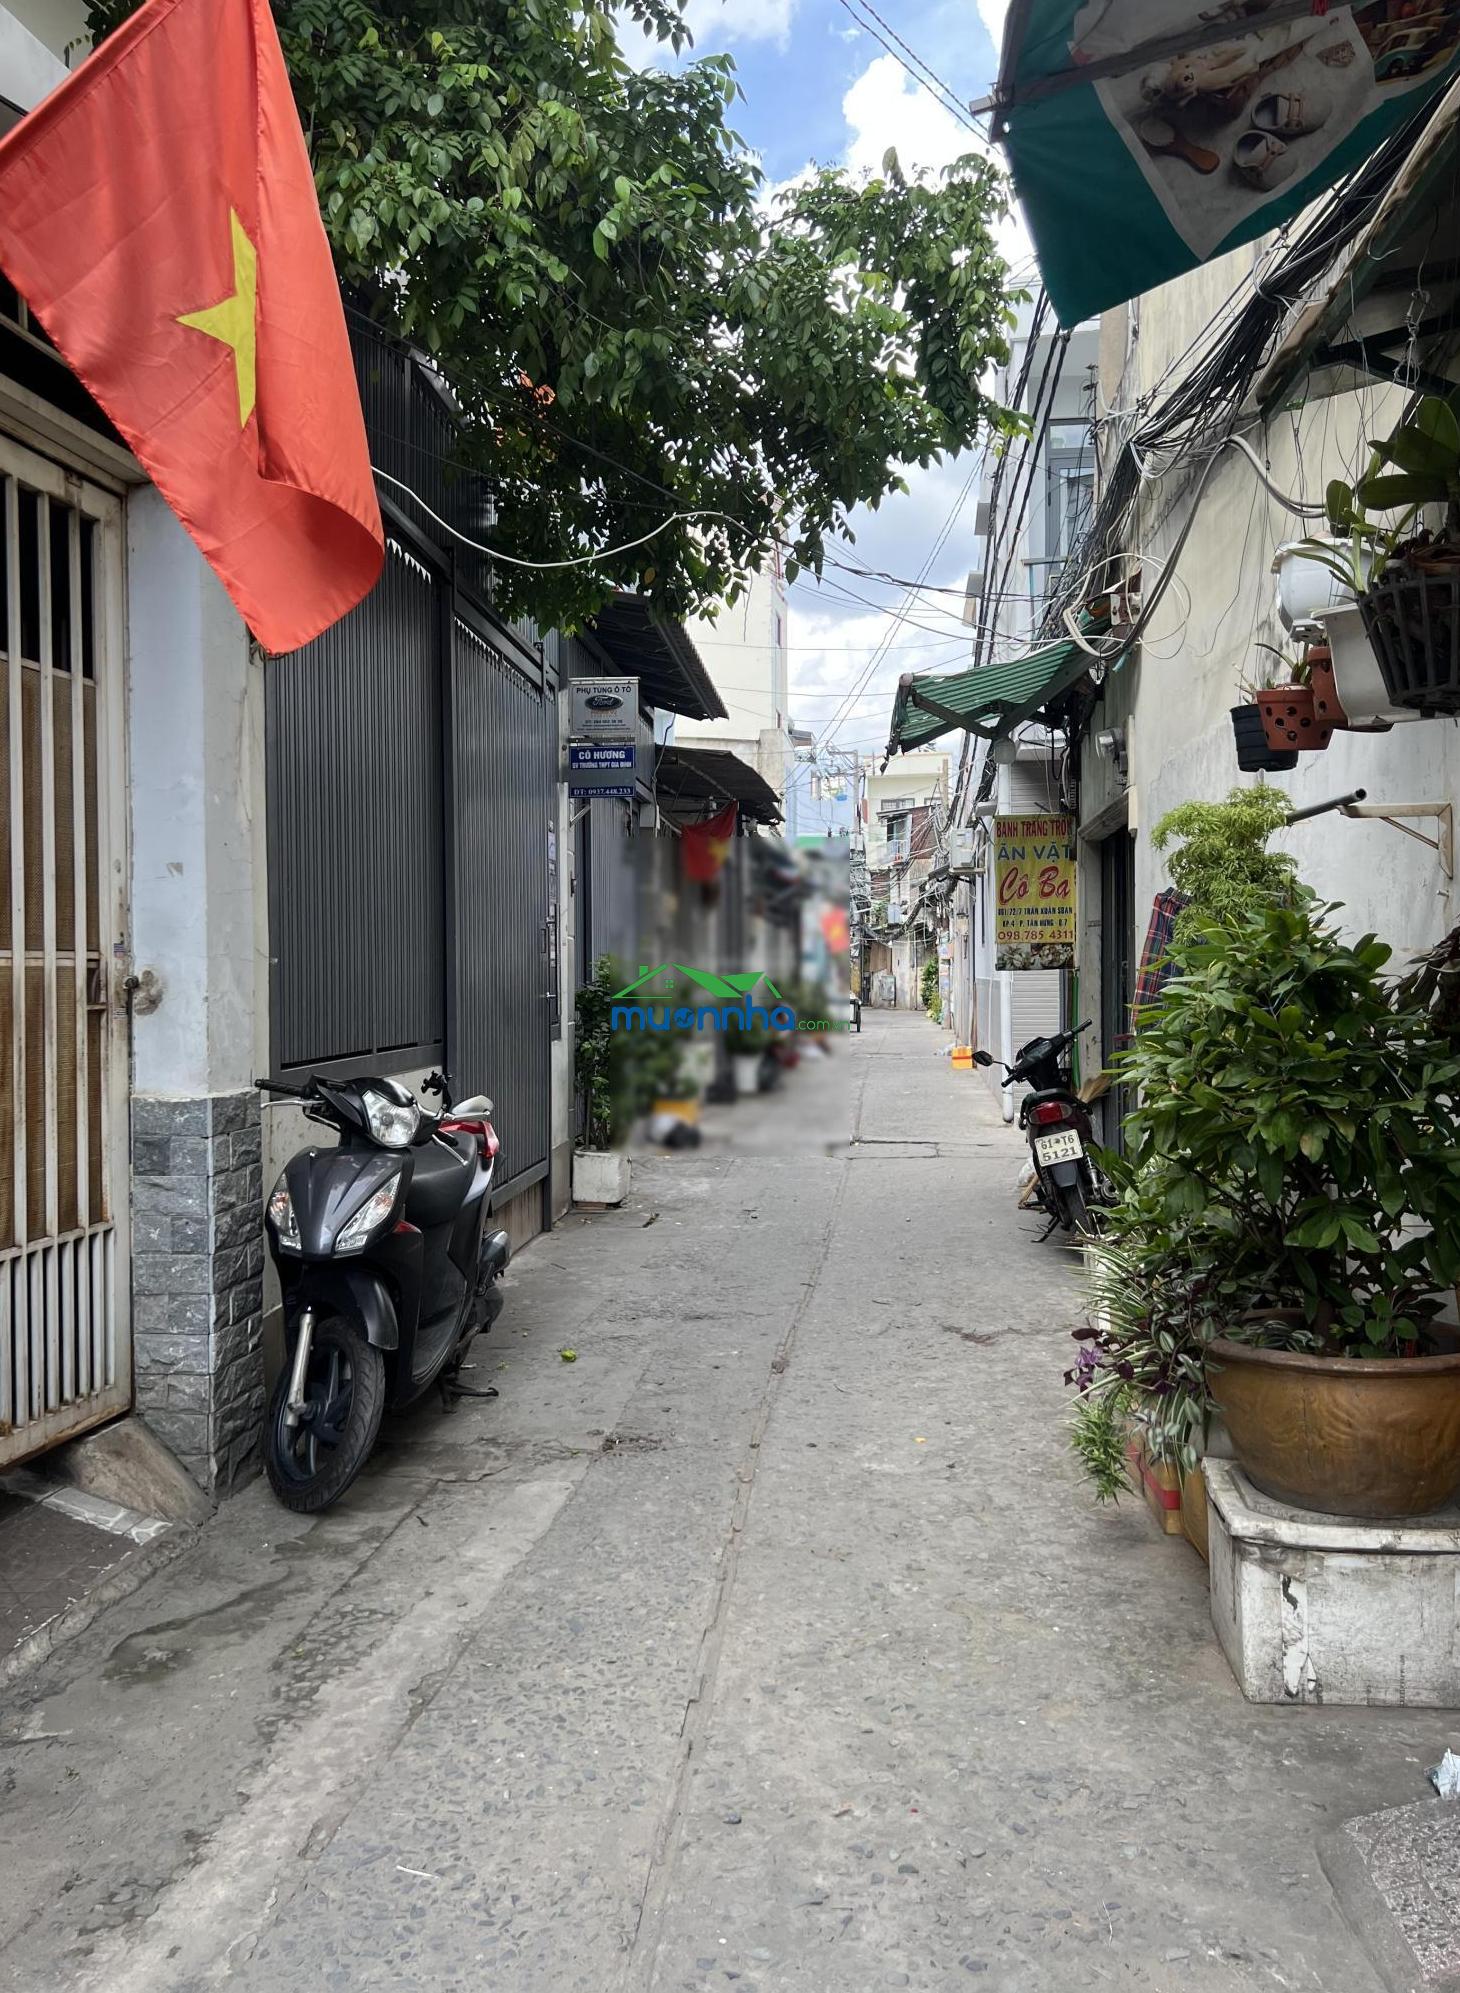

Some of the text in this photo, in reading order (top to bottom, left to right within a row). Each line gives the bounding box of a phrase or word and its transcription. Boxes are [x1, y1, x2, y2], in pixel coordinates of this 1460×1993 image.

[578, 749, 626, 760] CÔ HƯƠNG
[999, 865, 1071, 905] Cô Ba
[998, 929, 1073, 940] 098 785 4311
[1042, 1146, 1077, 1162] 5121
